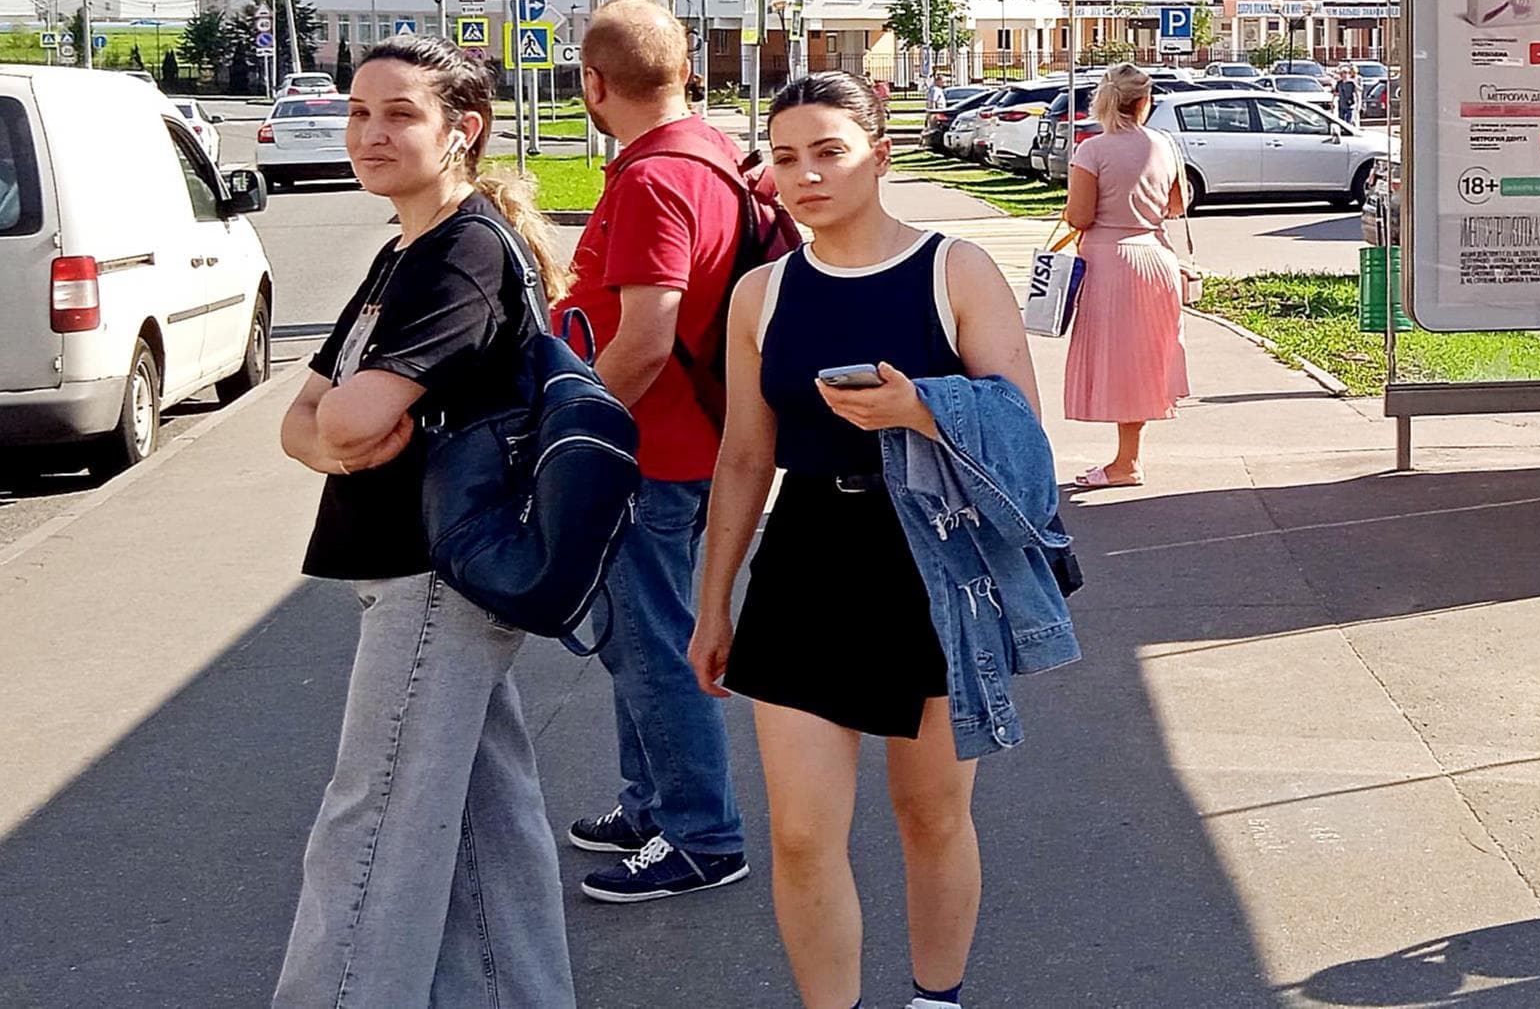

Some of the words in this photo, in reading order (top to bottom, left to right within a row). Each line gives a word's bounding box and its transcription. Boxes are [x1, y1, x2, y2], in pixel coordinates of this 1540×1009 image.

[1168, 10, 1186, 35] P
[1462, 176, 1499, 196] 18+
[1028, 254, 1054, 303] VISA
